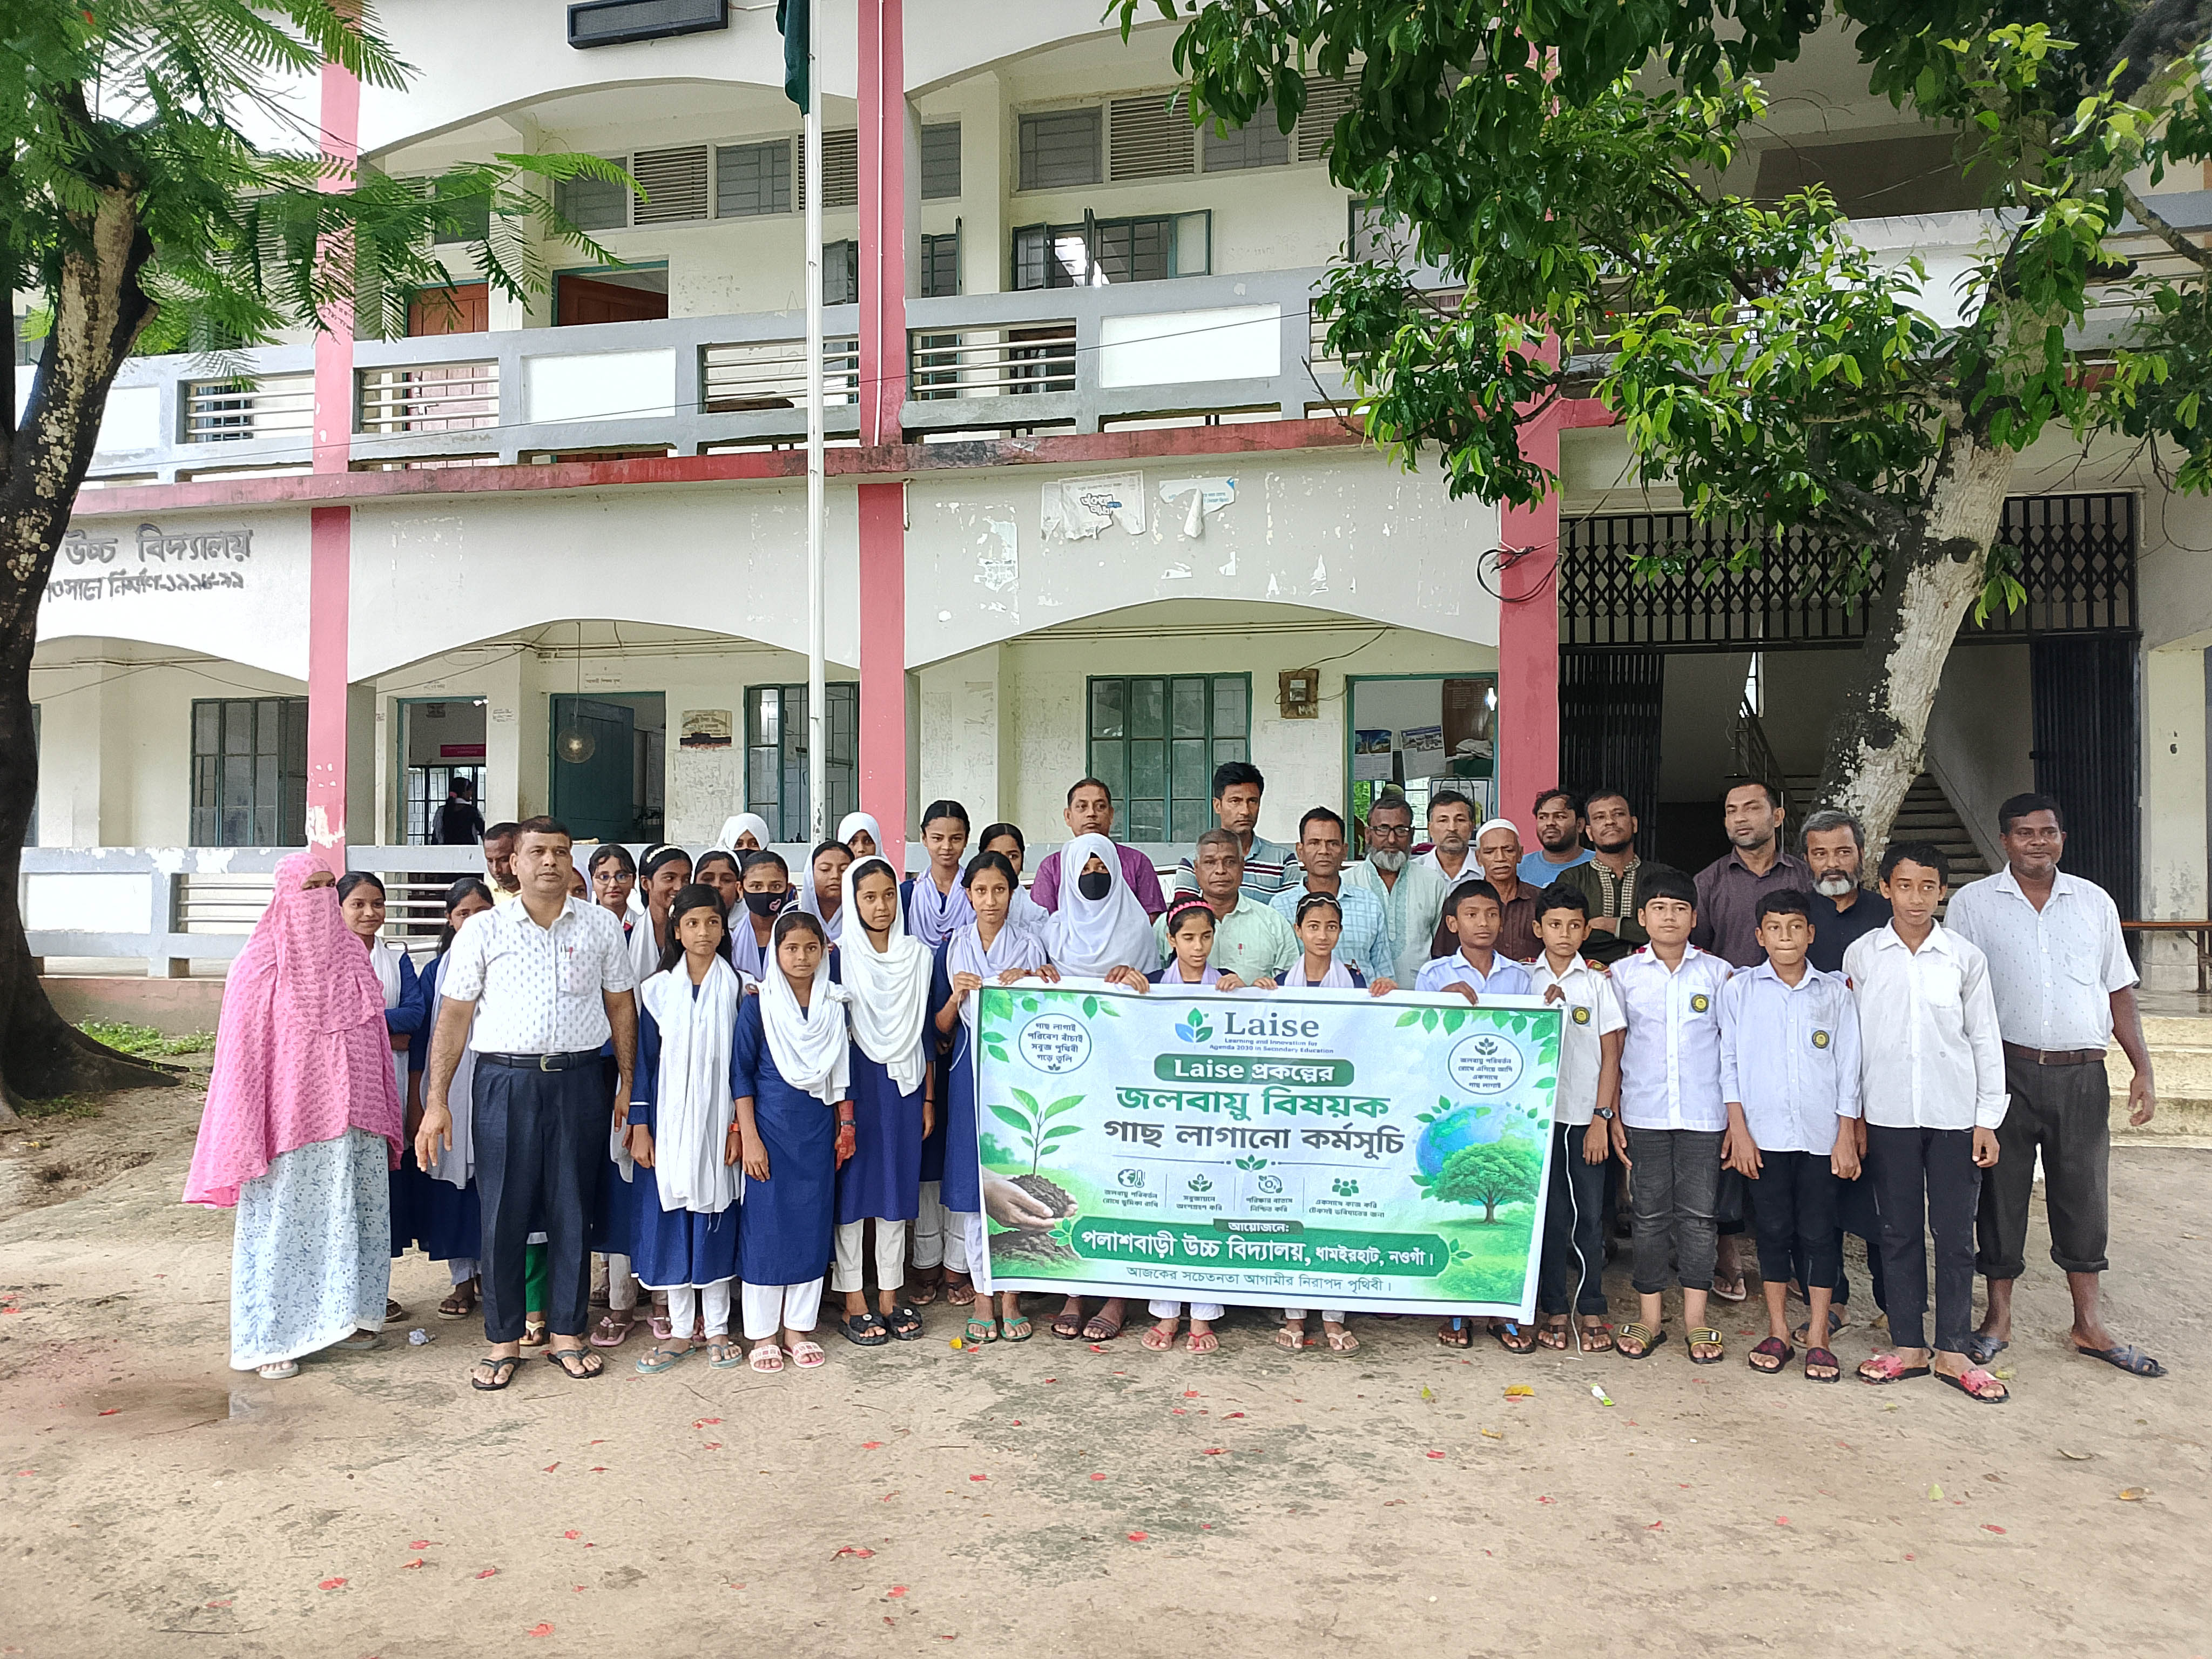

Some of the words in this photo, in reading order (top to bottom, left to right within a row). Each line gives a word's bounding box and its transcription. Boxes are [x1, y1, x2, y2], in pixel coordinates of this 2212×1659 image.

[64, 529, 118, 565] উচ্চ
[136, 523, 254, 563] বিদ্যালয়
[1028, 1031, 1058, 1041] পরিবেশ
[1053, 1023, 1076, 1032] লাগাই
[1224, 1011, 1319, 1037] Laise
[1031, 1043, 1052, 1052] সবুজ
[1055, 1043, 1078, 1053] পৃথিবী
[1056, 1054, 1072, 1063] তুলি
[1174, 1059, 1245, 1078] Laise
[1251, 1063, 1335, 1083] প্রকল্পের
[1115, 1086, 1252, 1121] জলবায়ু
[1261, 1085, 1391, 1118] বিষয়ক
[1103, 1121, 1165, 1148] গাছ
[1175, 1125, 1291, 1149] লাগানো
[1300, 1122, 1405, 1161] কর্মসূচি
[1081, 1230, 1178, 1259] পলাশবাড়ী
[1182, 1232, 1223, 1257] উচ্চ
[1225, 1235, 1311, 1266] বিদ্যালয়,
[1316, 1244, 1384, 1266] ধামইরহাট,
[1126, 1267, 1178, 1280] আজকের
[1182, 1271, 1240, 1284] সচেতনতা
[1243, 1272, 1294, 1286] আগামীর
[1298, 1274, 1343, 1290] নিরাপদ
